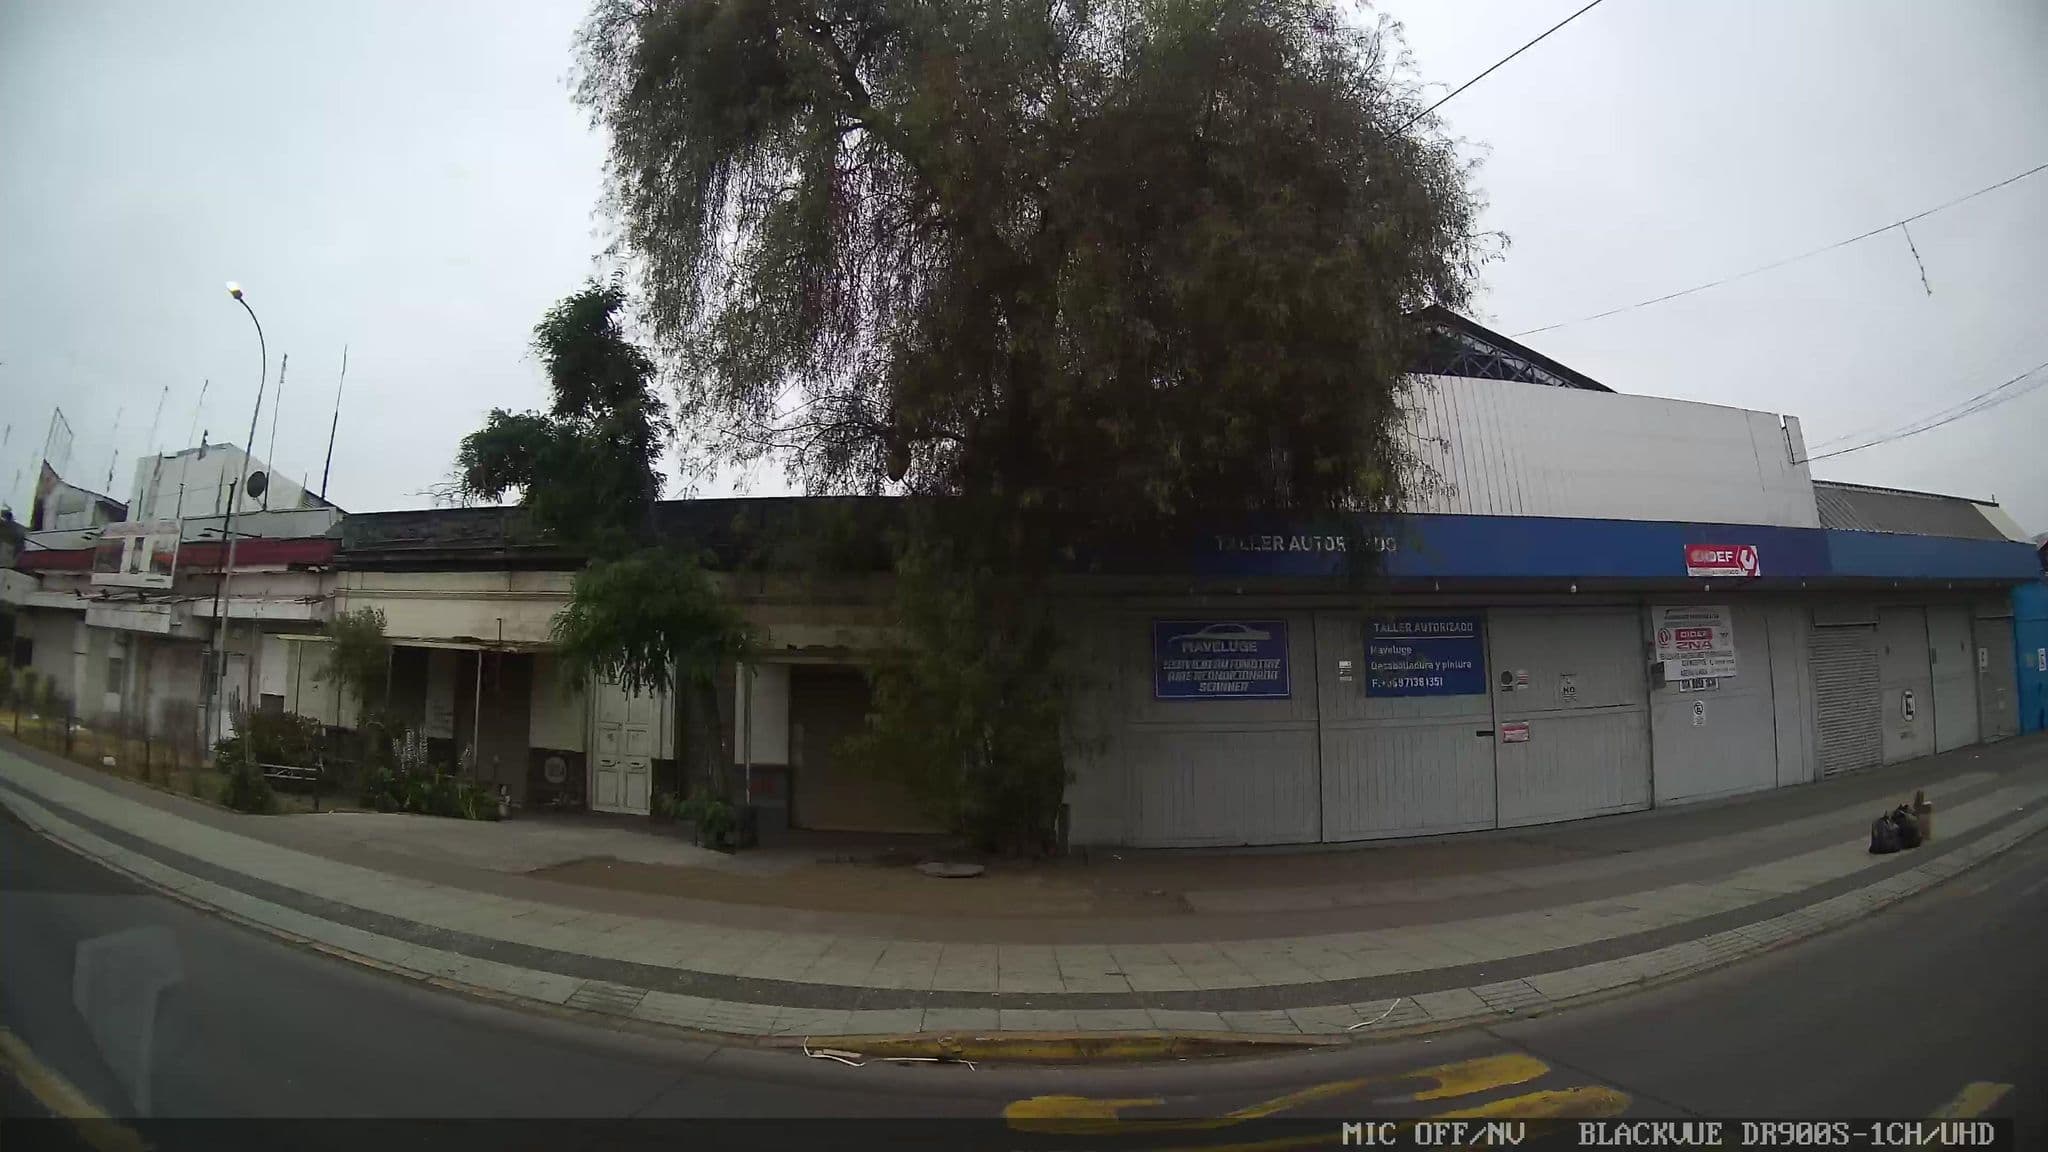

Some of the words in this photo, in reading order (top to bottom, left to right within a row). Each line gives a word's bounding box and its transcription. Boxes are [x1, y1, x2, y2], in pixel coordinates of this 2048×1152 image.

[1288, 535, 1398, 552] AUTORDO
[1373, 622, 1412, 633] TALLER
[1414, 622, 1473, 633] AUTORIZADO
[1442, 660, 1473, 672] pintura
